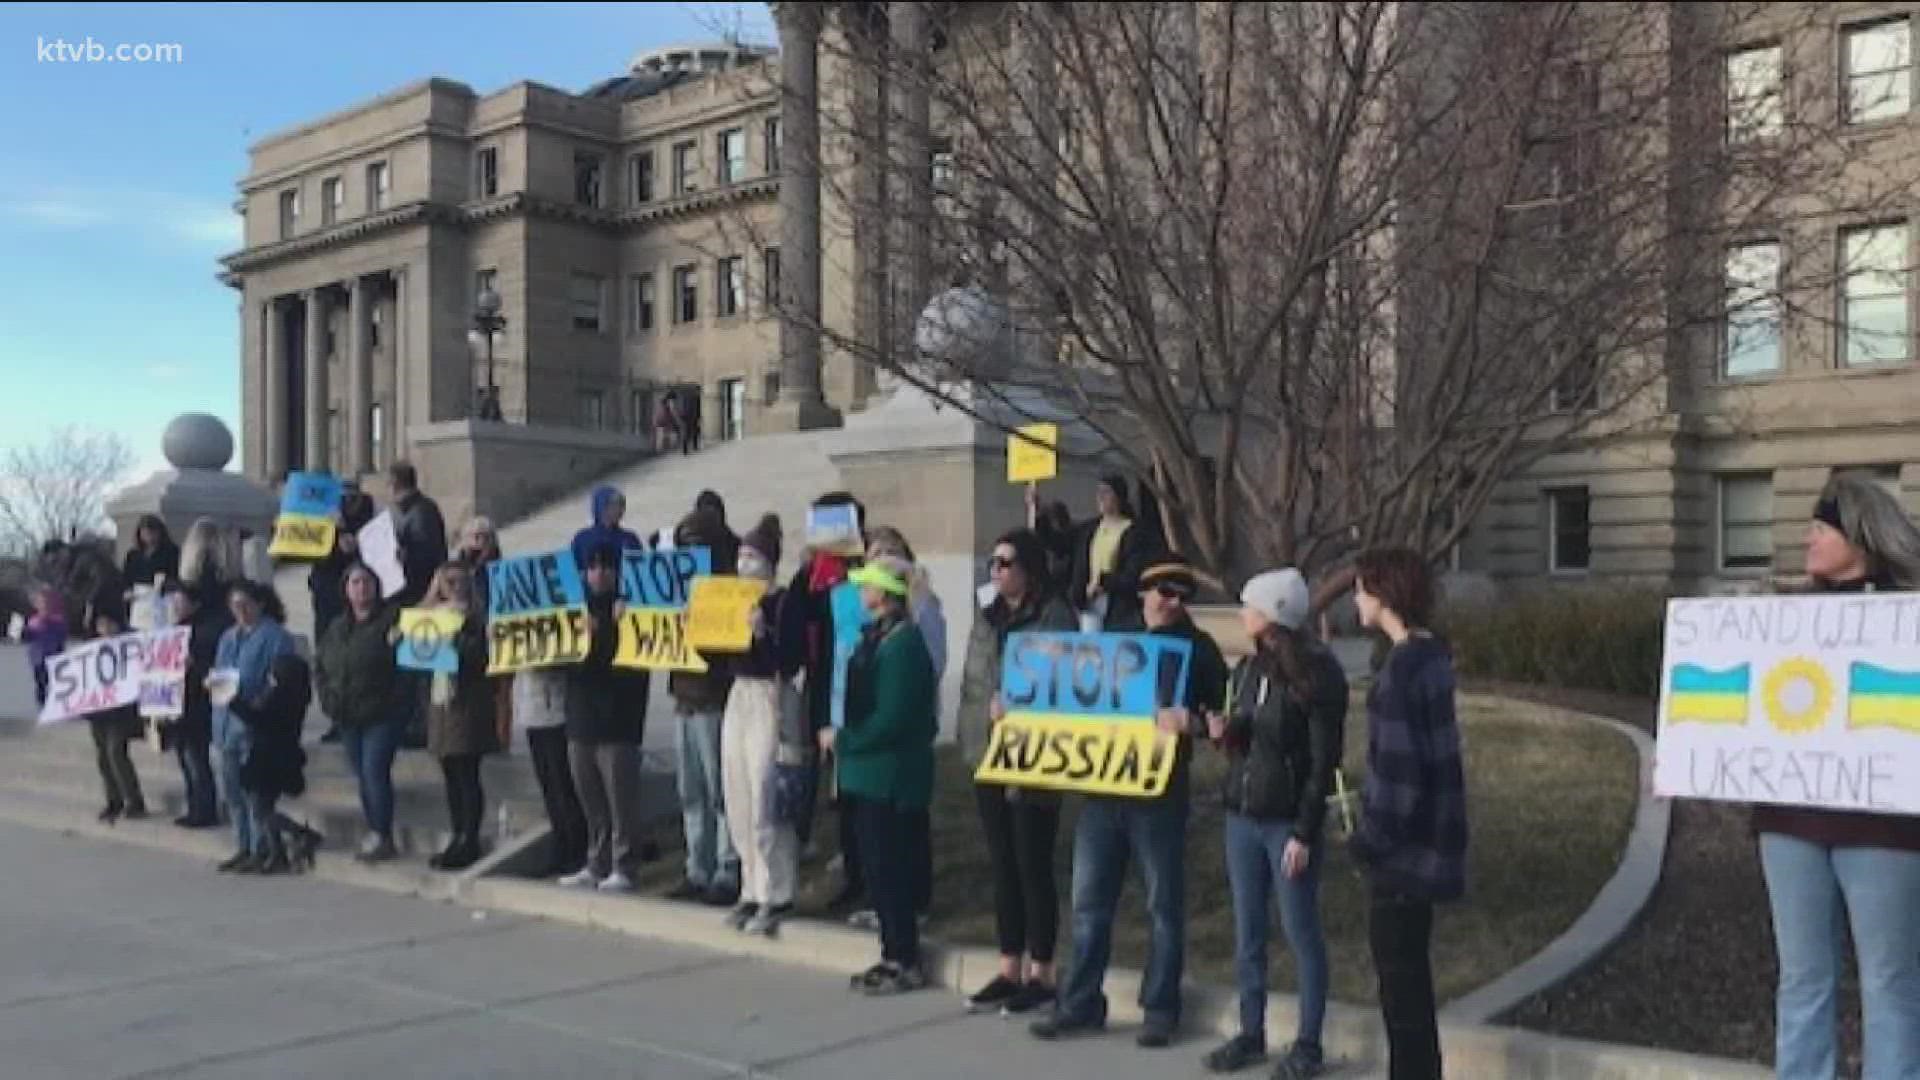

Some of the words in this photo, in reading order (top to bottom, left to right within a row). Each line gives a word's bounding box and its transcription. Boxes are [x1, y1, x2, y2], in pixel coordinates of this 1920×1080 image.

[491, 609, 586, 666] PEOPLE
[1671, 600, 1801, 647] STAND
[1811, 598, 1920, 652] WIT
[53, 639, 143, 701] STOP
[989, 723, 1165, 791] RUSSIA!
[1687, 746, 1895, 806] UKRAINE
